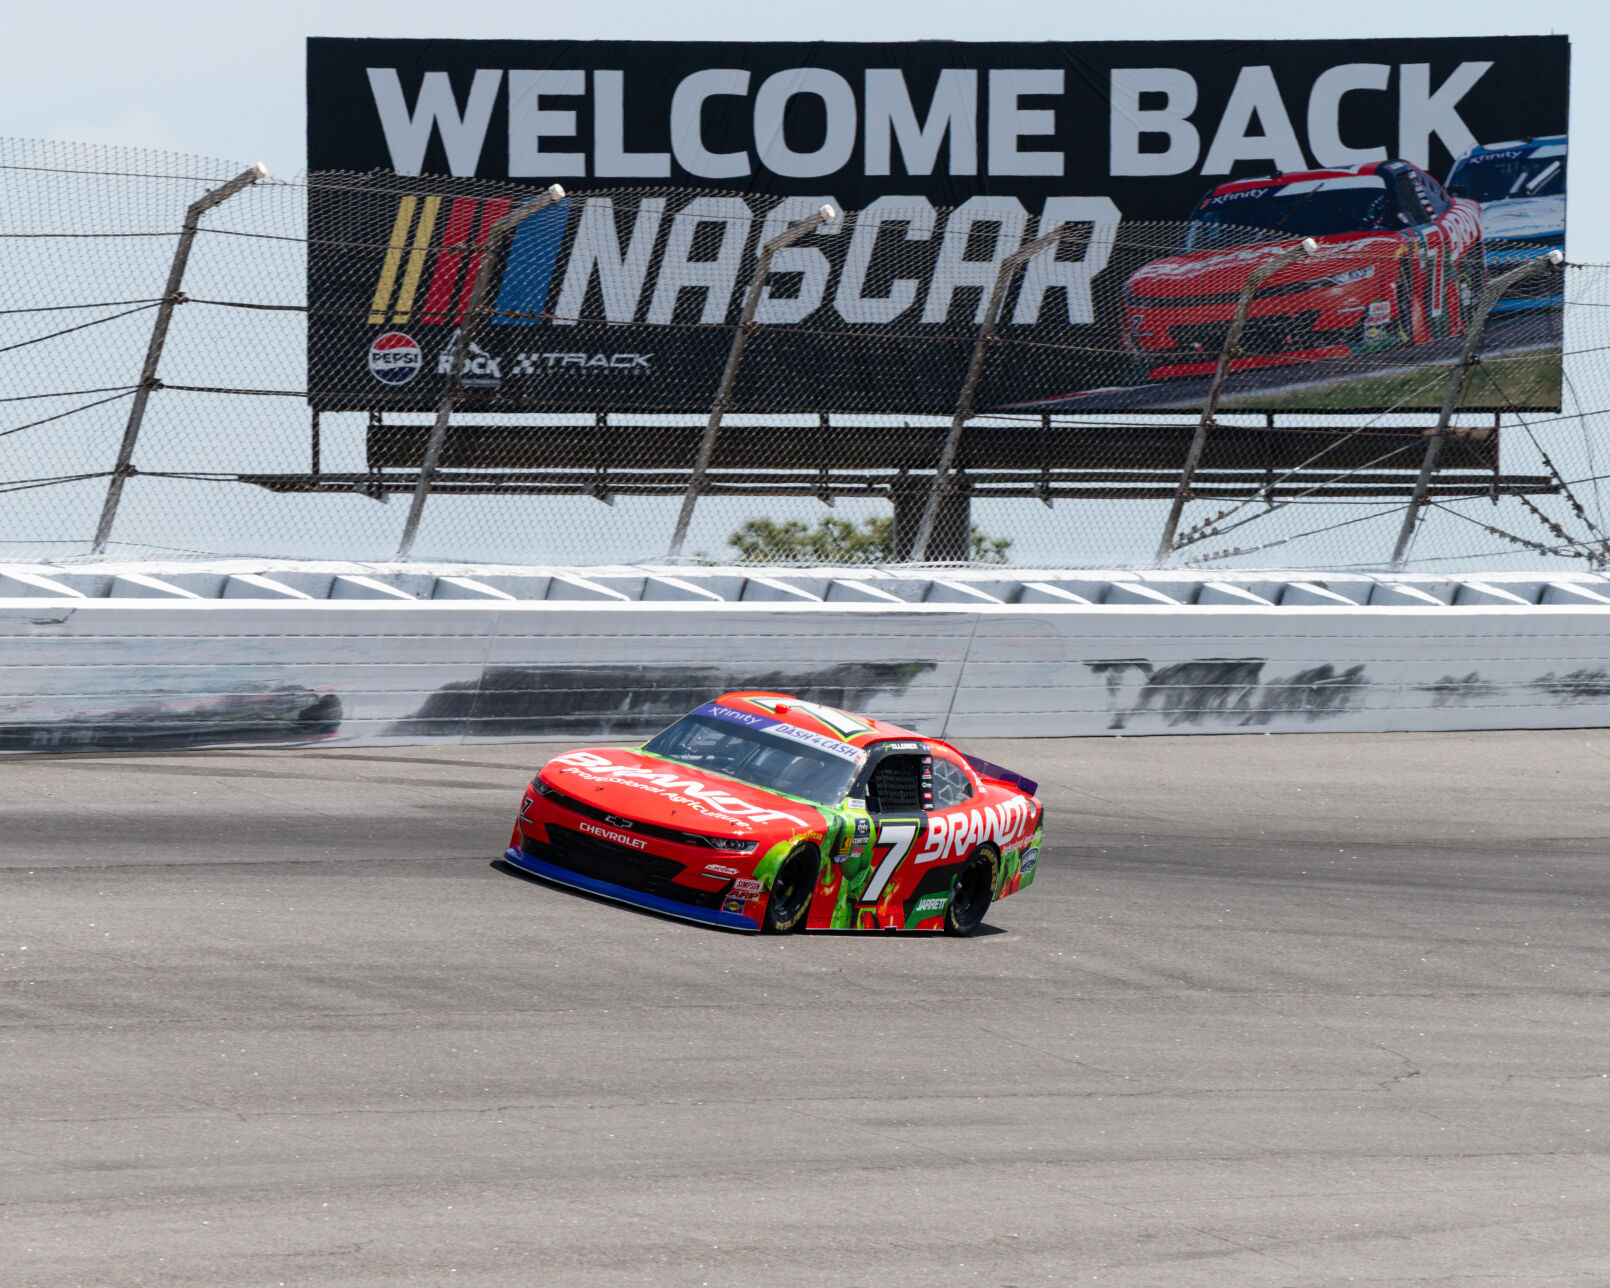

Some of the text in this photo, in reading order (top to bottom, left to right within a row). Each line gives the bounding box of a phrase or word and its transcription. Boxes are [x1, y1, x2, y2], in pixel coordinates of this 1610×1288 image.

[366, 61, 1494, 178] WELCOME BACK
[552, 195, 1122, 326] NASCAR
[708, 706, 763, 725] xfinity
[775, 724, 812, 743] DASH
[821, 740, 857, 758] CASH
[548, 751, 808, 827] BRANDT
[520, 798, 534, 816] 7
[579, 822, 648, 850] CHEVROLET
[914, 795, 1030, 865] BRANDT
[859, 822, 918, 904] 7
[736, 880, 761, 891] SIMPSON
[916, 898, 948, 911] JARRETT
